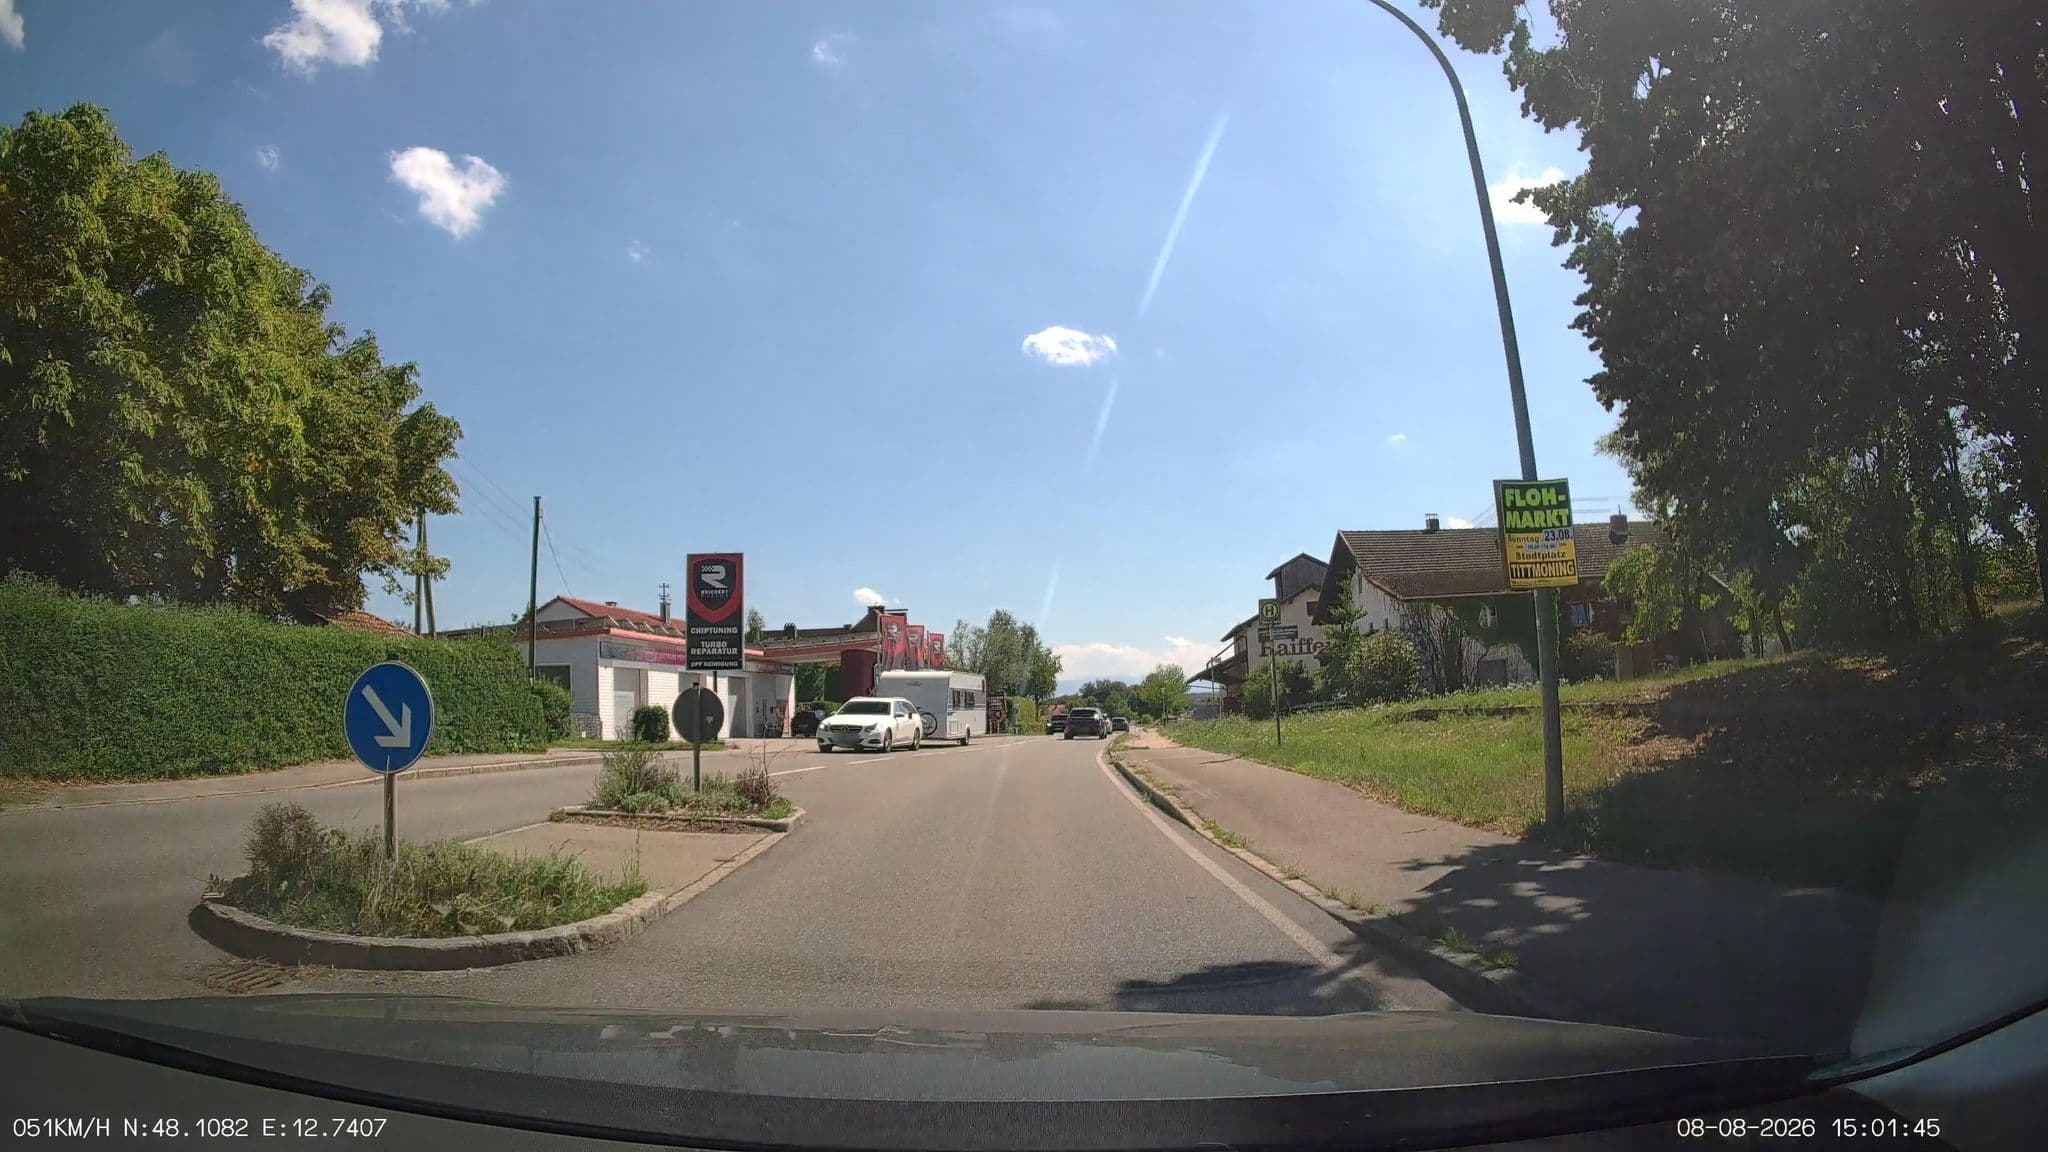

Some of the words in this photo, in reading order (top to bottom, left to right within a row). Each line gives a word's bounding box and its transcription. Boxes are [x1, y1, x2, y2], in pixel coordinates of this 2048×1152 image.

[1505, 487, 1566, 507] FLOH-
[1506, 508, 1569, 529] MARKT
[1508, 535, 1540, 543] Sonntag
[1515, 550, 1566, 561] Stadtplatz
[1510, 560, 1575, 578] TITTMONING
[1265, 605, 1274, 616] H
[690, 647, 738, 655] REPARATUR
